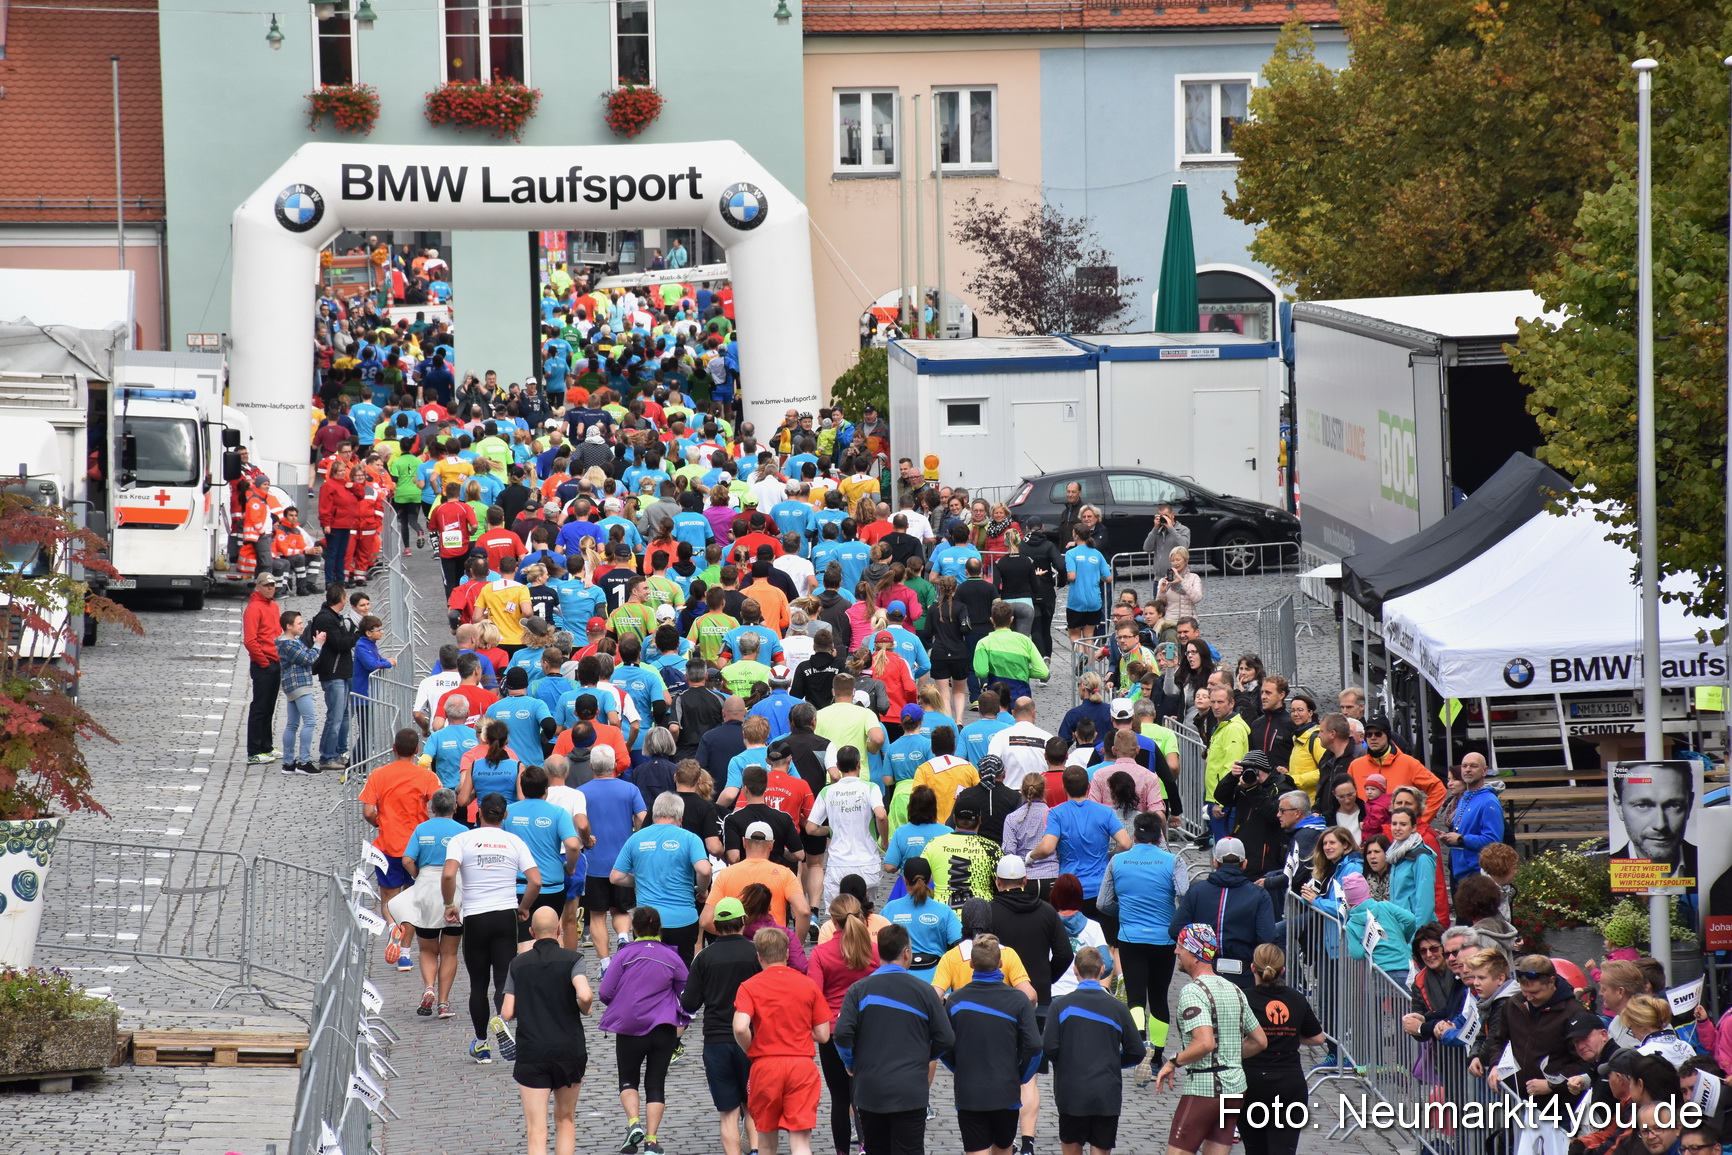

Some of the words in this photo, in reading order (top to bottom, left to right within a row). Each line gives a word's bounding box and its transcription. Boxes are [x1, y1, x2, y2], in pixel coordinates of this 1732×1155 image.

[281, 184, 322, 202] BMW
[341, 163, 469, 203] BMW
[482, 165, 703, 210] Laufsport
[725, 183, 764, 200] BMW
[236, 402, 305, 410] www.bmw-laufsport.de
[751, 394, 818, 406] www.bmw-laufsport.de
[1379, 414, 1418, 507] BOC
[129, 493, 150, 501] Kreuz
[612, 583, 626, 608] 1
[1506, 658, 1532, 670] BMW
[1550, 654, 1633, 684] BMW
[1641, 652, 1729, 681] aufs
[803, 667, 813, 677] SV
[1577, 705, 1592, 714] NM
[1596, 704, 1603, 713] X
[1605, 703, 1630, 713] 1106
[1569, 724, 1635, 736] SCHMITZ
[835, 790, 858, 798] Partner
[477, 854, 506, 868] Dynamics
[358, 913, 374, 925] swn
[1672, 991, 1696, 1006] swn
[1464, 1021, 1478, 1041] swn
[353, 1083, 370, 1098] swn
[1701, 1089, 1711, 1111] swn
